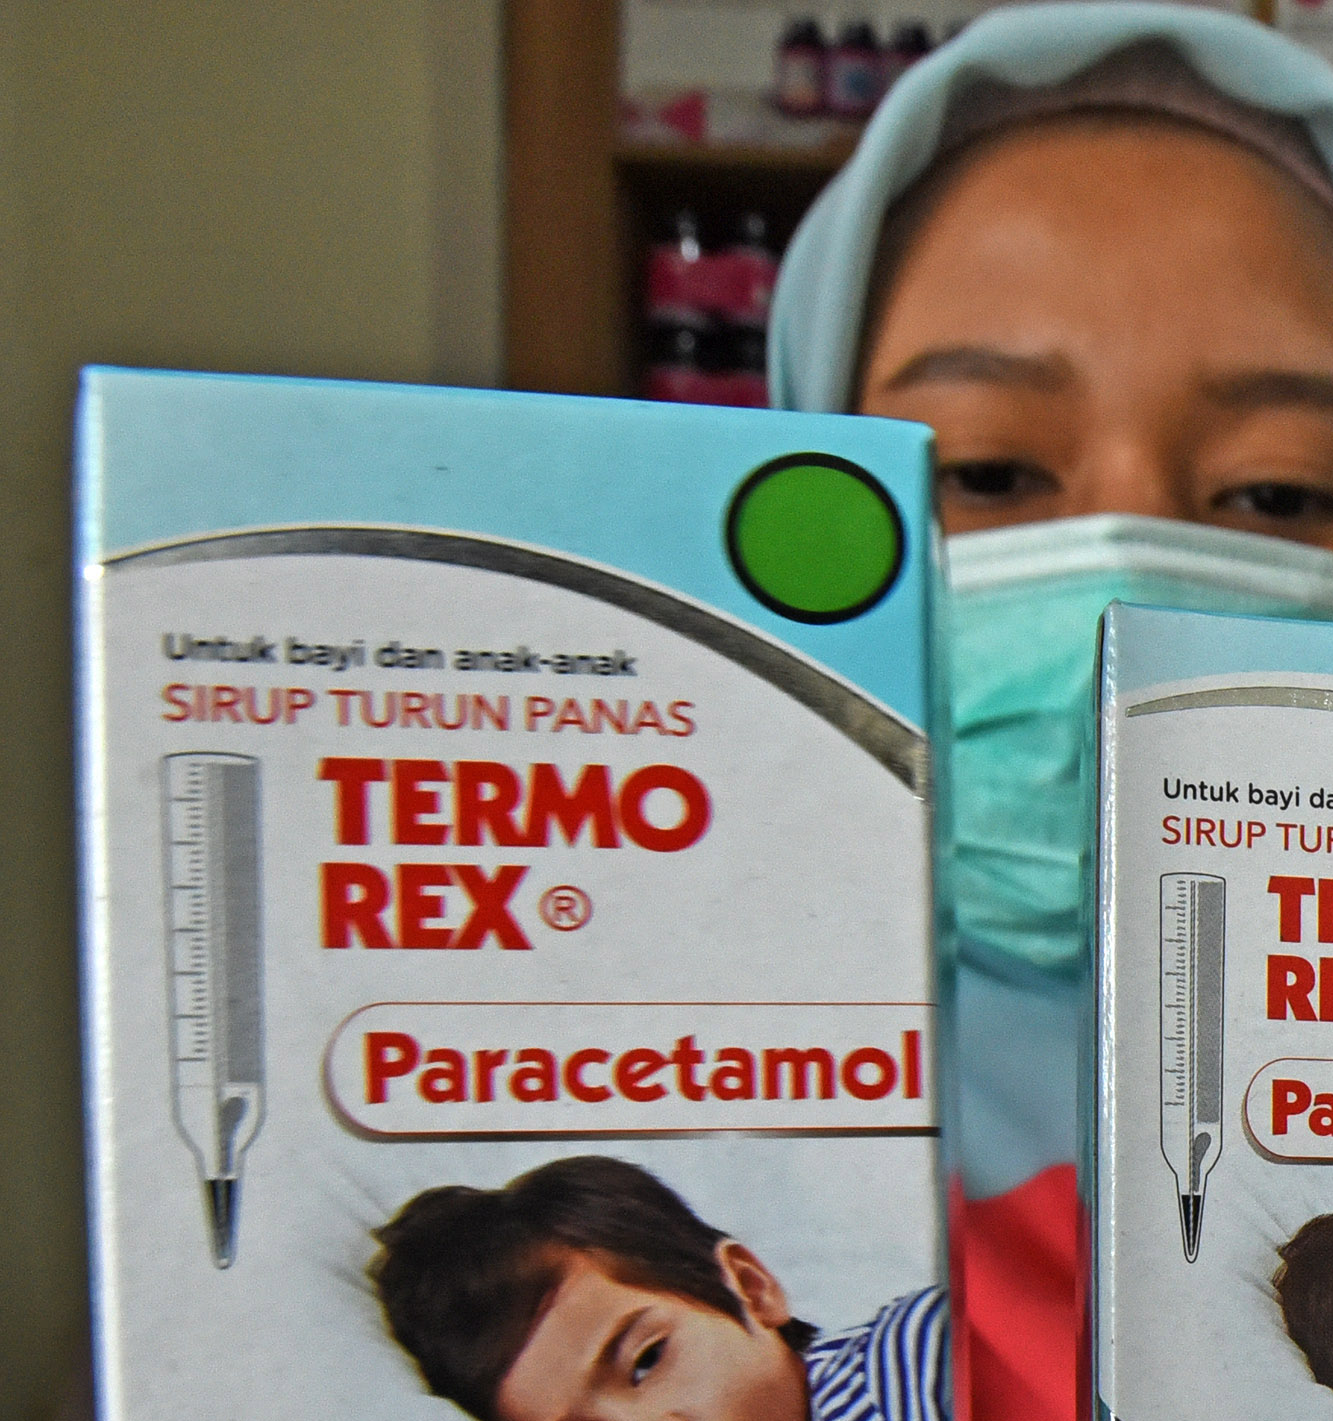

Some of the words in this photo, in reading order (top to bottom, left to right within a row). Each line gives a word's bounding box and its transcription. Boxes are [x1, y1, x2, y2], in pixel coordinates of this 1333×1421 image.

[163, 633, 277, 663] Untuk
[286, 636, 365, 672] bayi
[374, 641, 444, 669] dan
[453, 646, 637, 676] anak-anak
[162, 683, 316, 725] SIRUP
[325, 689, 510, 731] TURUN
[526, 695, 696, 737] PANAS
[318, 757, 711, 852] TERMO
[1163, 777, 1238, 803] Untuk
[1248, 782, 1299, 810] bayi
[1162, 815, 1266, 849] SIRUP
[366, 1030, 921, 1104] Paracetamol
